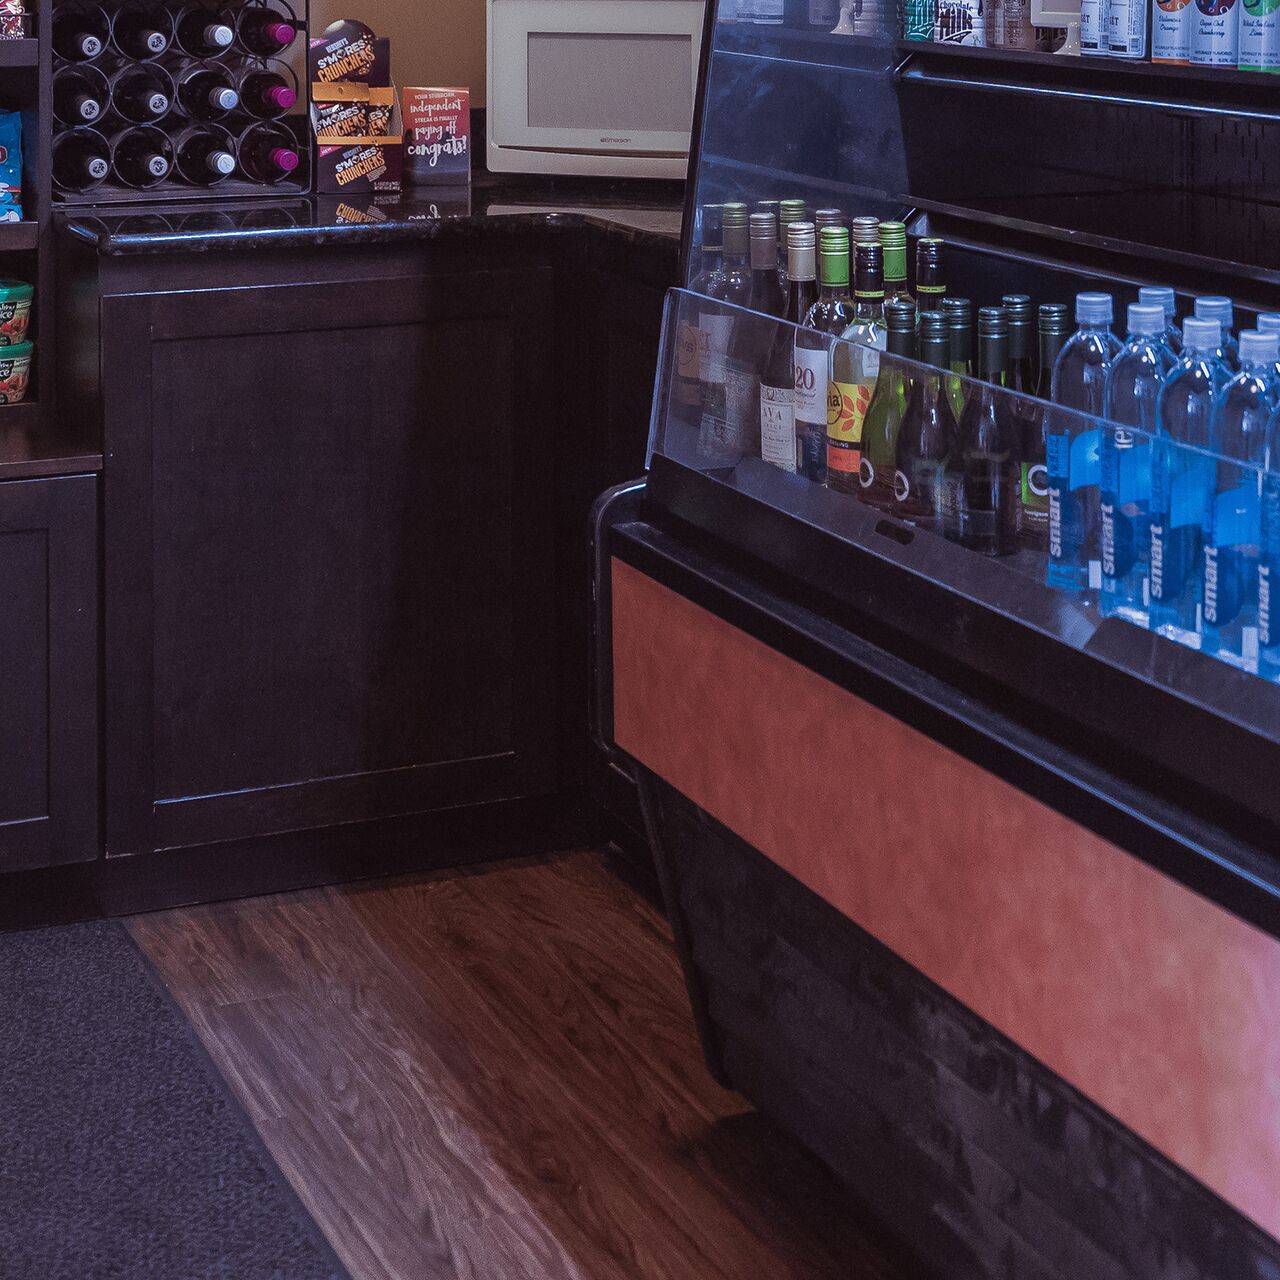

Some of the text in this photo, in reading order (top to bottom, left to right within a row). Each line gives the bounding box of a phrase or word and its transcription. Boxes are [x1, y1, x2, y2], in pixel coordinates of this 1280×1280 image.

[317, 39, 366, 69] S'MORES
[410, 98, 465, 116] independent
[415, 120, 457, 141] paying off
[335, 146, 377, 173] S'MORES
[407, 135, 467, 167] congrats!
[335, 152, 386, 186] CRUNCHERS
[1048, 487, 1062, 558] smart
[1100, 502, 1115, 576] smart
[1150, 523, 1163, 600] smart
[1204, 545, 1218, 623] smart
[1257, 564, 1271, 645] smart
